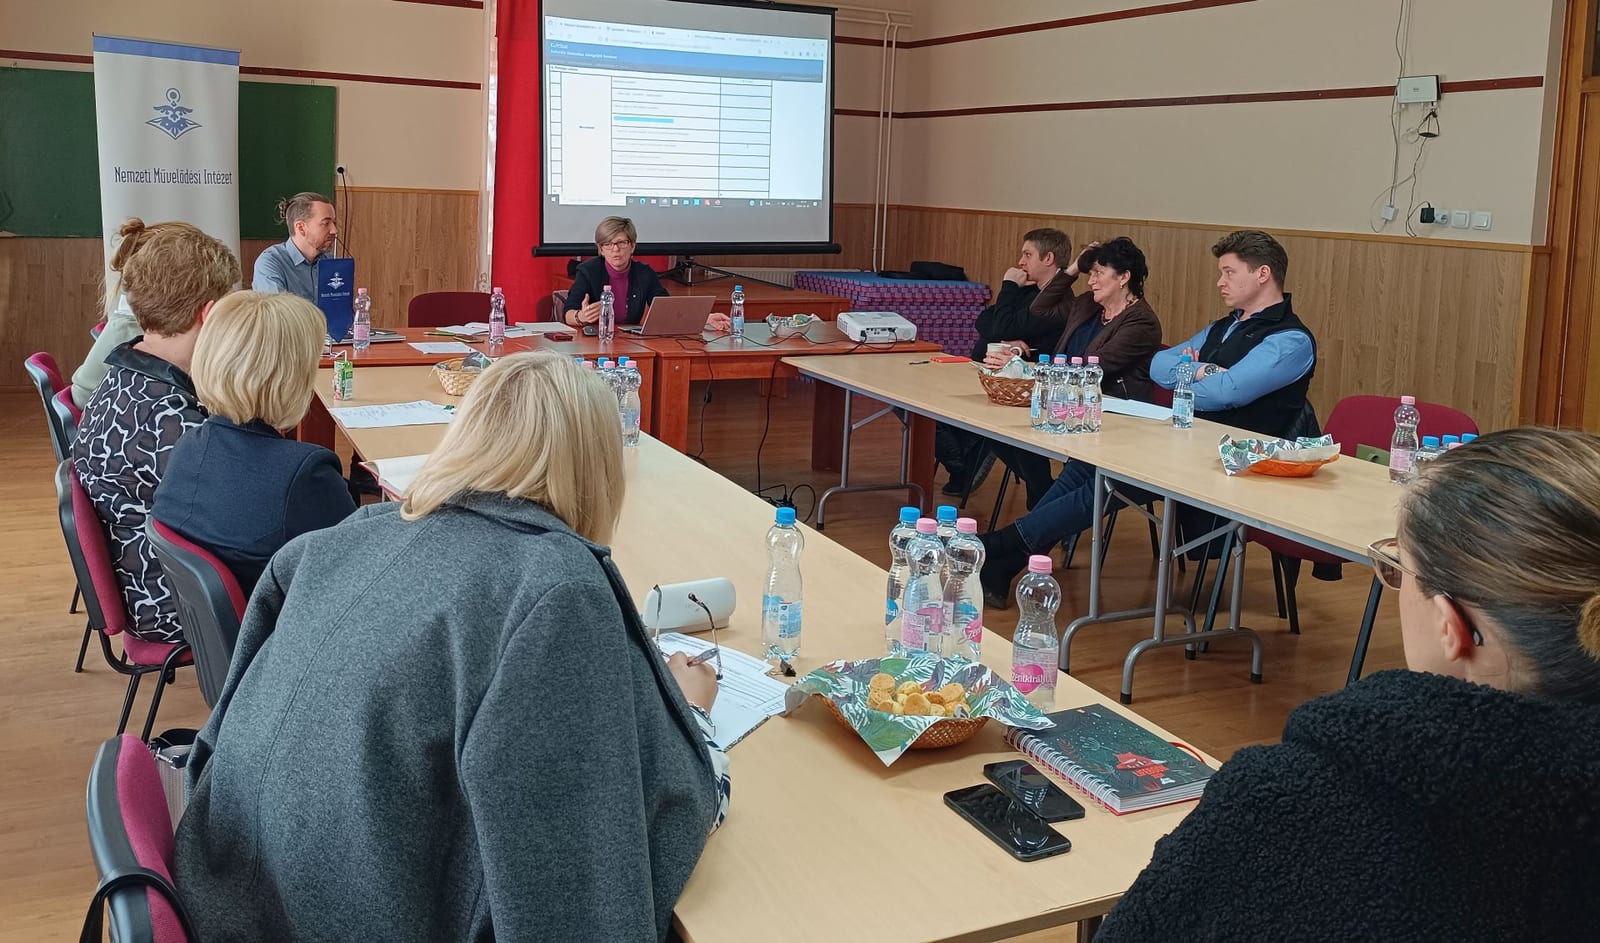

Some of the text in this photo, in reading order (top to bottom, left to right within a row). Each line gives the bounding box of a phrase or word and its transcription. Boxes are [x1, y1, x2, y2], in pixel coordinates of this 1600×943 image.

[114, 167, 232, 185] Nemzeti Művelődési Intézet
